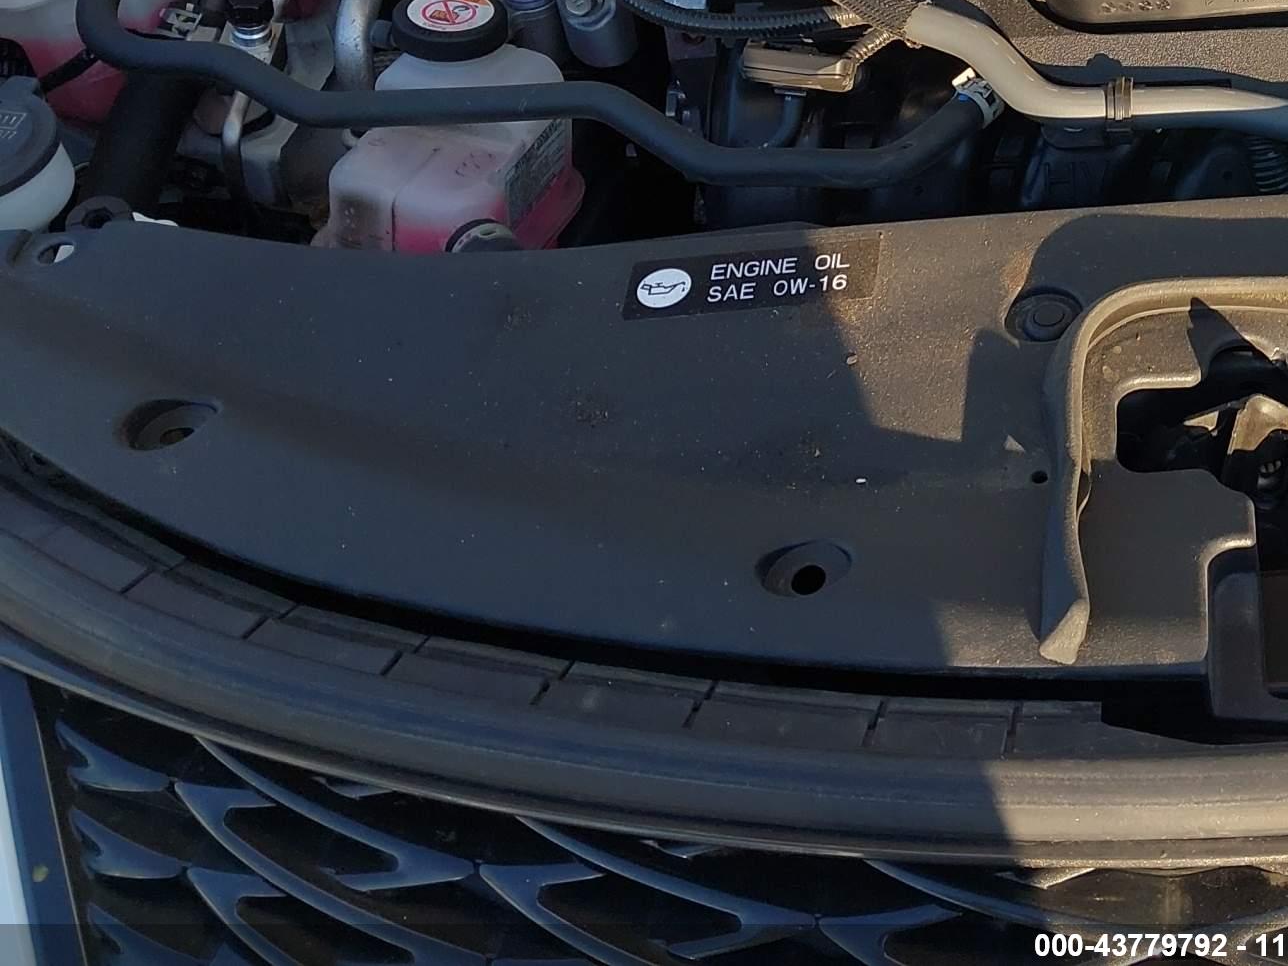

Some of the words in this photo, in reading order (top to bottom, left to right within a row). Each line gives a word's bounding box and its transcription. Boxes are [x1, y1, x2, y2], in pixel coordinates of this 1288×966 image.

[710, 257, 798, 281] ENGINE
[814, 253, 850, 271] OIL
[706, 282, 756, 303] SAE
